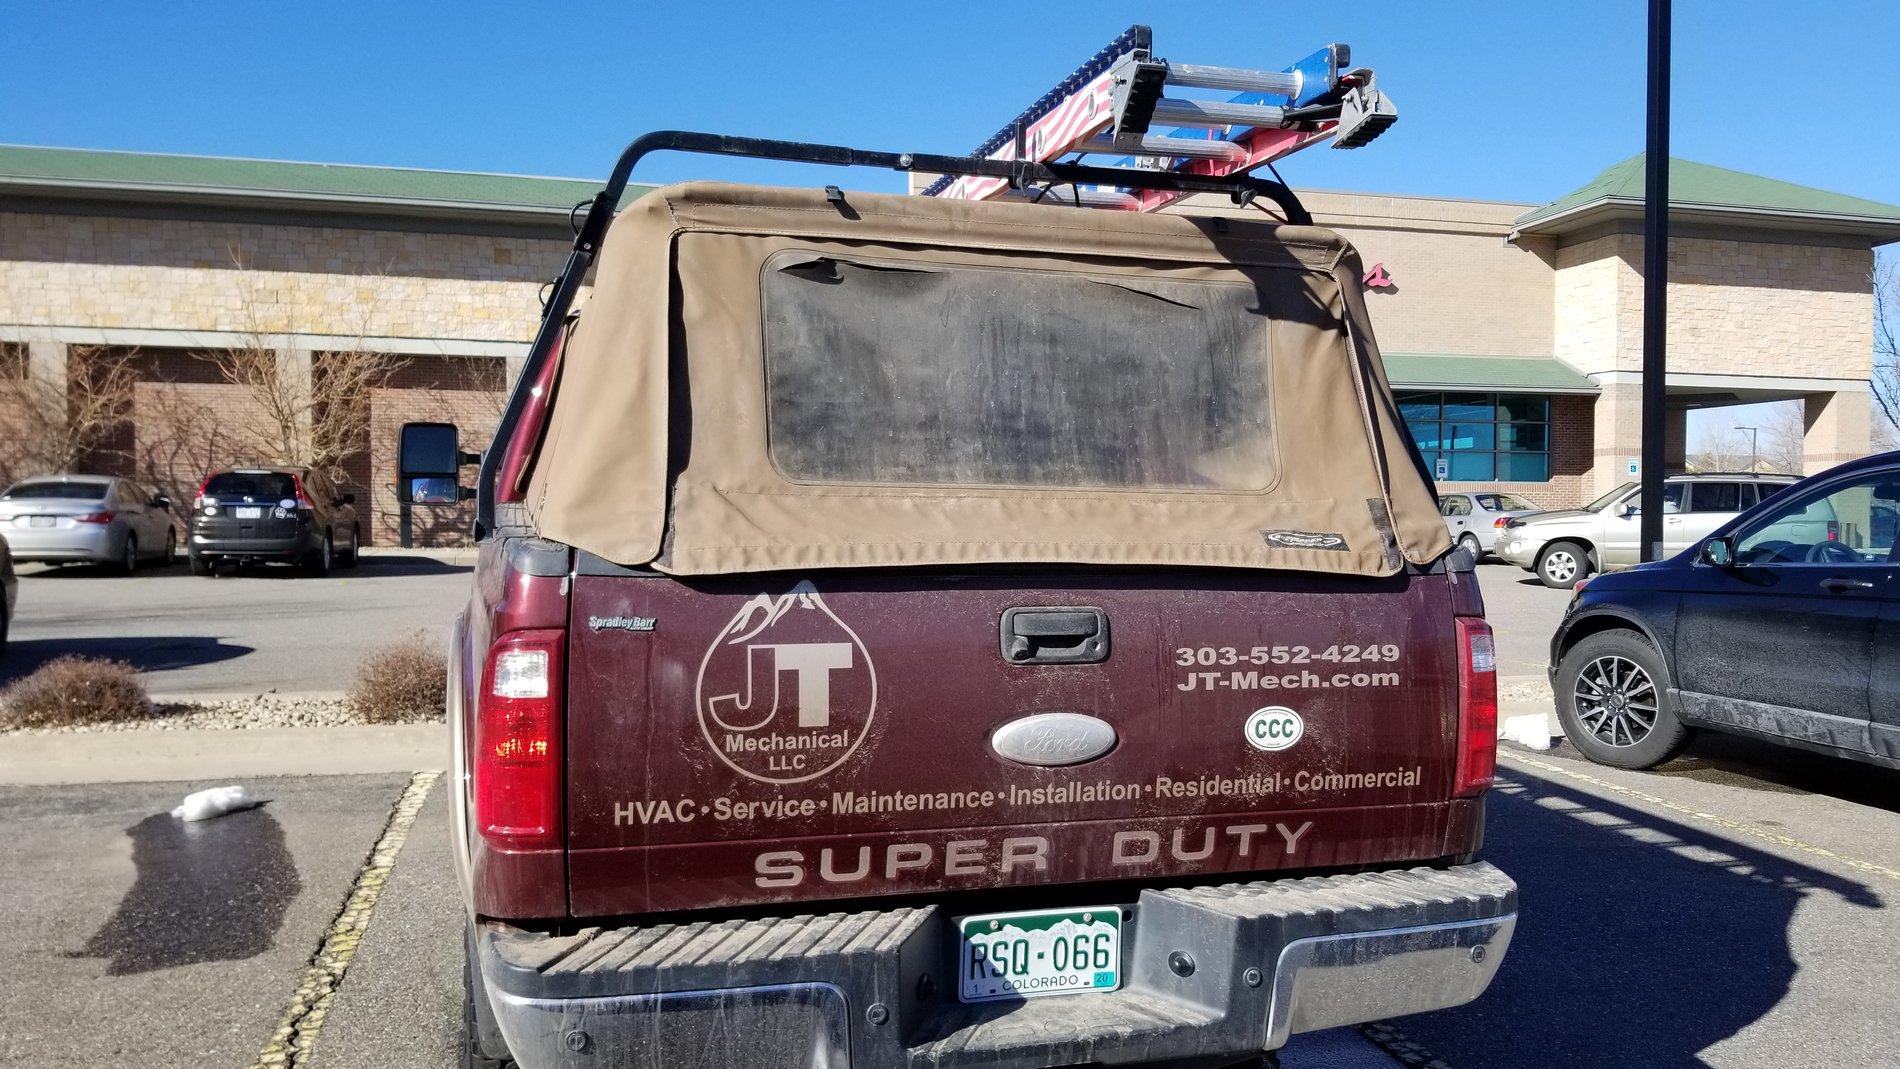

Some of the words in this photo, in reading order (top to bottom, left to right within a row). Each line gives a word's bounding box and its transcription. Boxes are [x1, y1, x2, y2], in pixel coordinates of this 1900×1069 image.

[1175, 644, 1400, 666] 303-552-4249
[708, 642, 853, 731] JT
[1177, 670, 1399, 691] JT-Mech.com
[1255, 718, 1294, 739] CCC
[725, 730, 849, 752] Mechanical
[1024, 727, 1089, 753] Ford
[769, 754, 806, 771] LLC
[614, 798, 696, 826] HVAC
[714, 794, 815, 821] Service
[832, 789, 994, 815] Maintenance
[1010, 779, 1140, 806] Installation
[1155, 771, 1281, 798] Residential
[1294, 766, 1422, 793] Commercial
[754, 836, 1048, 888] SUPER
[1112, 821, 1312, 864] DUTY
[1002, 974, 1079, 991] COLORADO
[1096, 973, 1108, 983] 20
